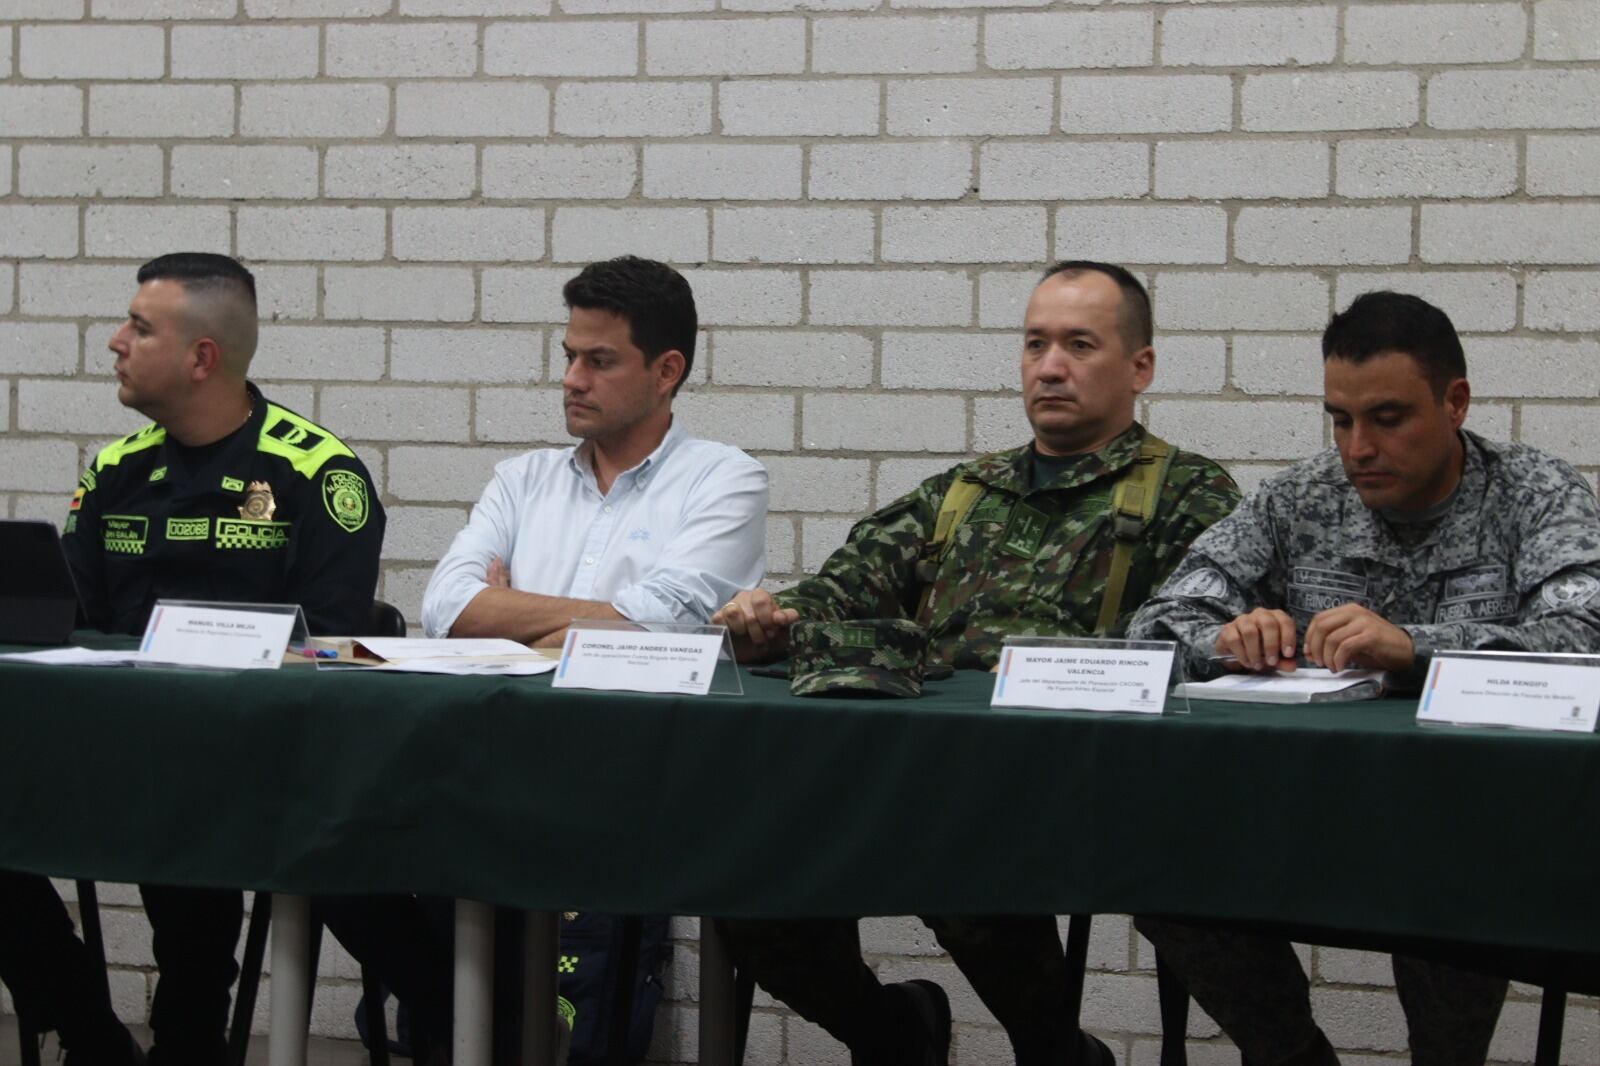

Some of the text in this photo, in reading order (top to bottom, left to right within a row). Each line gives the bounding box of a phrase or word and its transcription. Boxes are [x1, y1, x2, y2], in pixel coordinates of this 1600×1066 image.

[1305, 593, 1352, 609] RINCO
[1439, 603, 1473, 623] FUERZA
[669, 646, 703, 654] VANEGAS
[1079, 658, 1117, 666] EDUARDO
